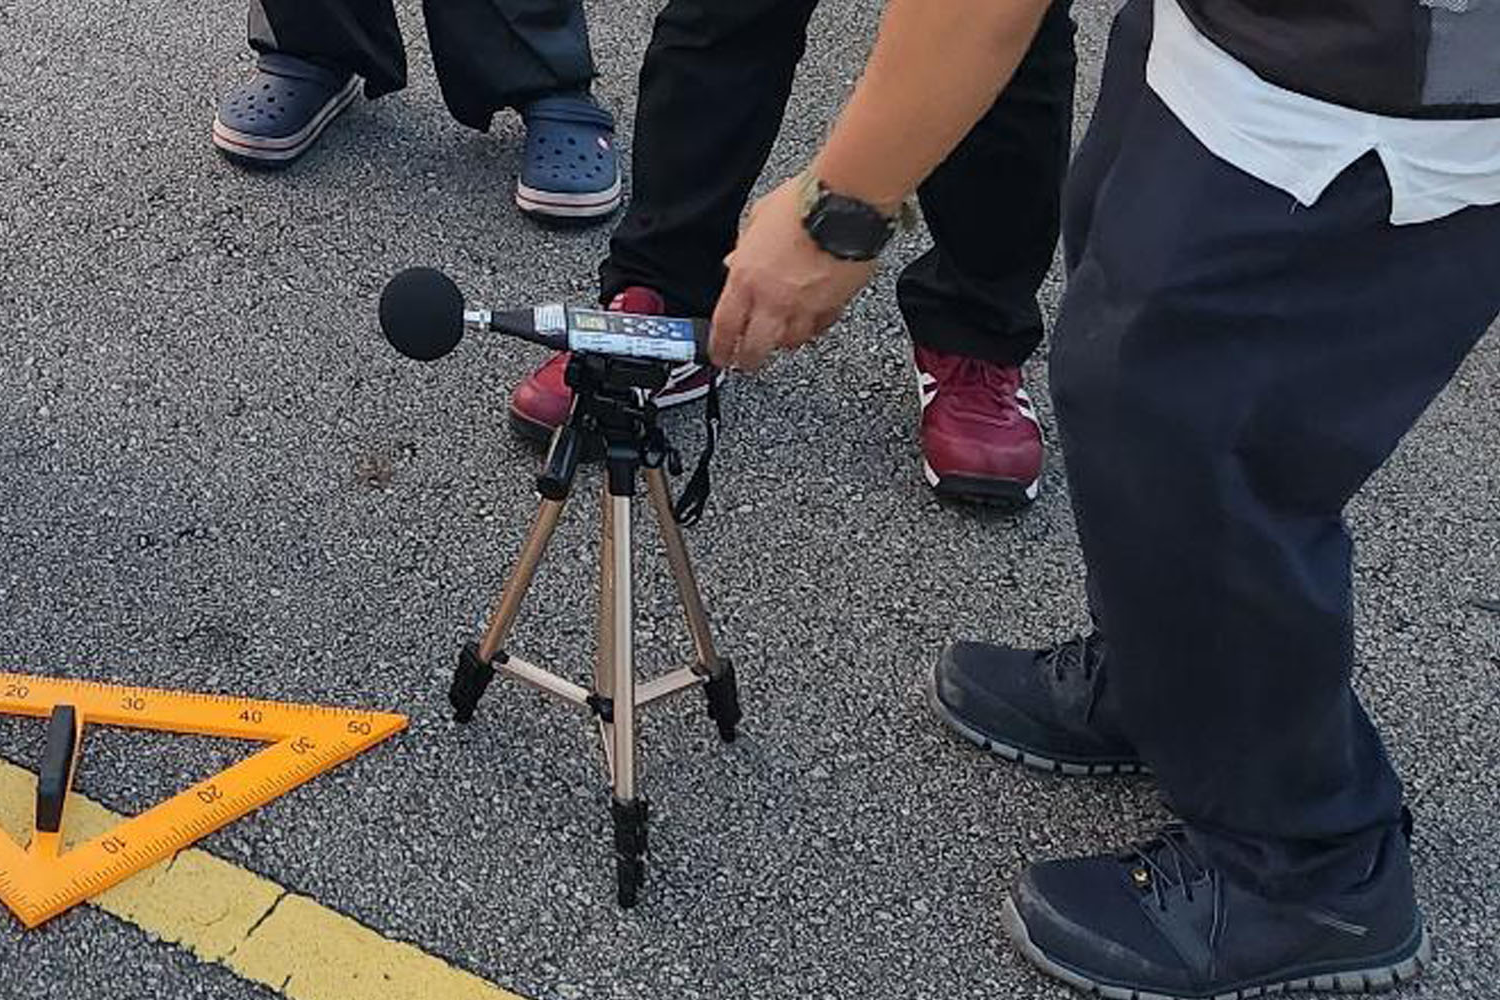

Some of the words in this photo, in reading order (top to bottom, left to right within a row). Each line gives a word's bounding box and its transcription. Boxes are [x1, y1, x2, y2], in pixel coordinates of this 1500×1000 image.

[5, 683, 29, 700] 20
[120, 696, 146, 712] 30
[238, 709, 264, 725] 40
[347, 720, 373, 736] 50
[196, 784, 225, 806] 20
[101, 835, 127, 855] 10
